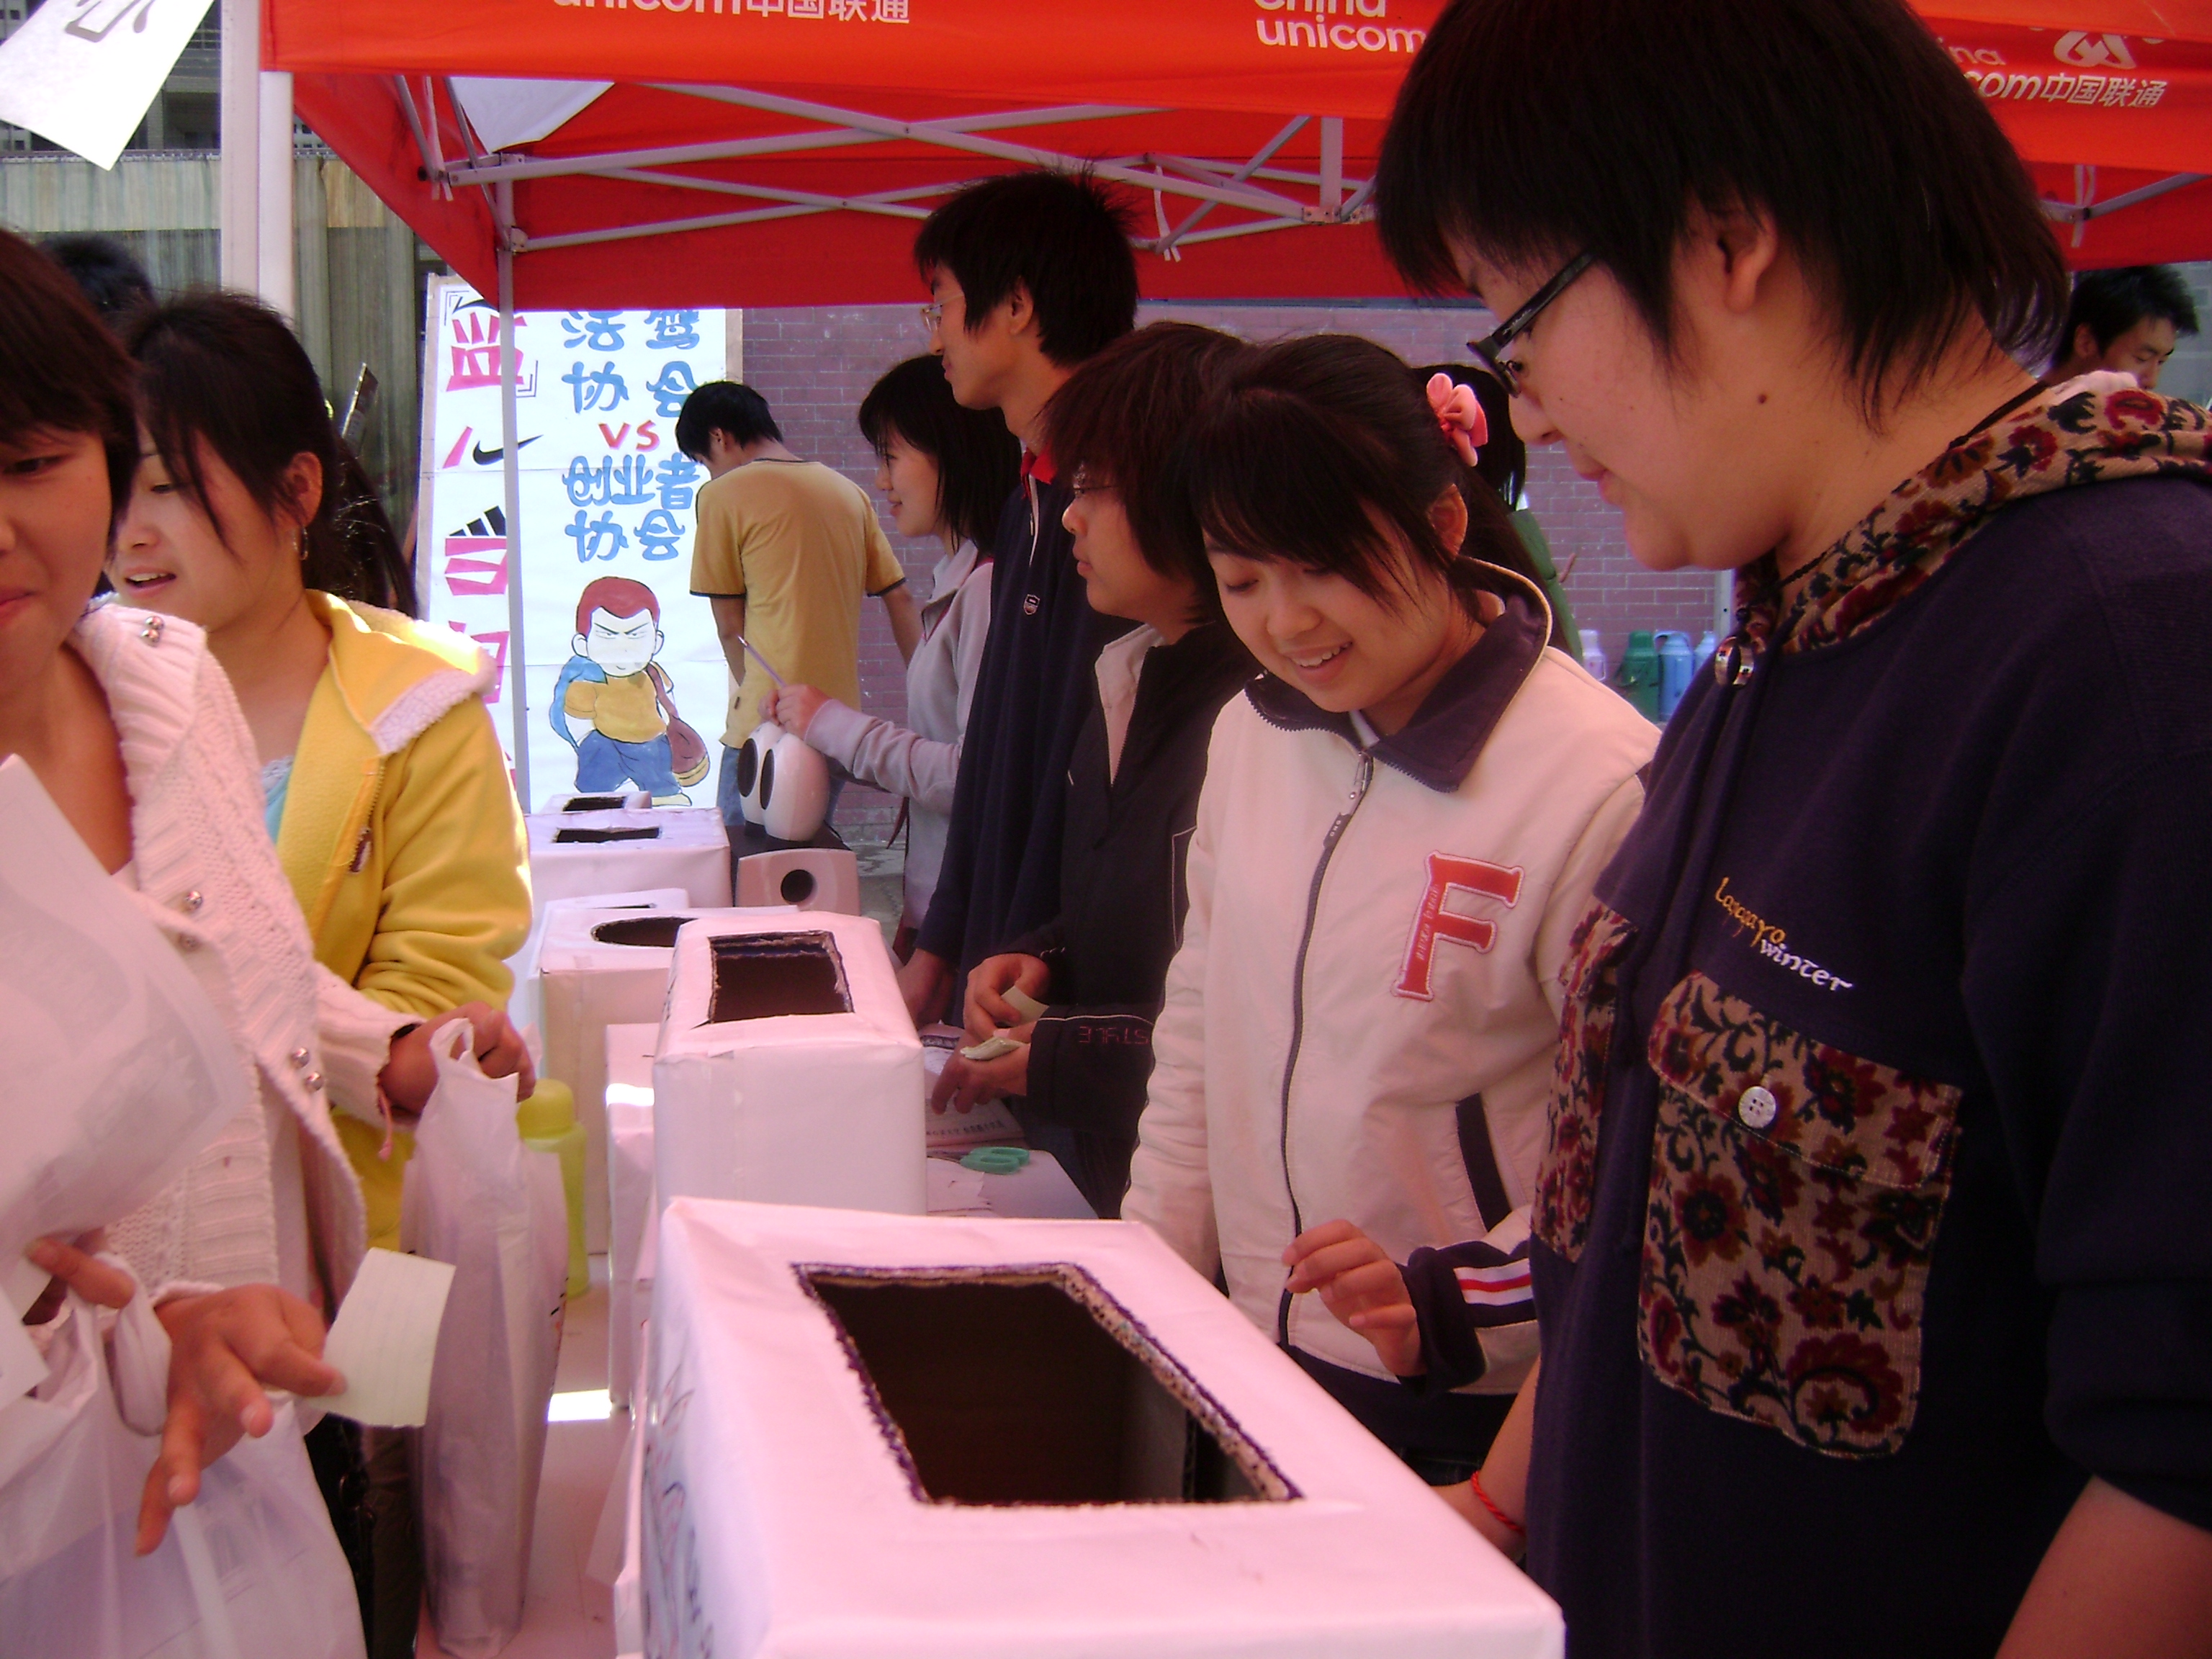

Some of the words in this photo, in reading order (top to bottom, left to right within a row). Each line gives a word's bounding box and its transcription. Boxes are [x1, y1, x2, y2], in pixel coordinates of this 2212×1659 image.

[1256, 14, 1426, 53] unicom
[562, 452, 701, 510] 创业者
[565, 509, 685, 562] 协会
[1390, 850, 1525, 1002] F
[1760, 939, 1854, 992] winter
